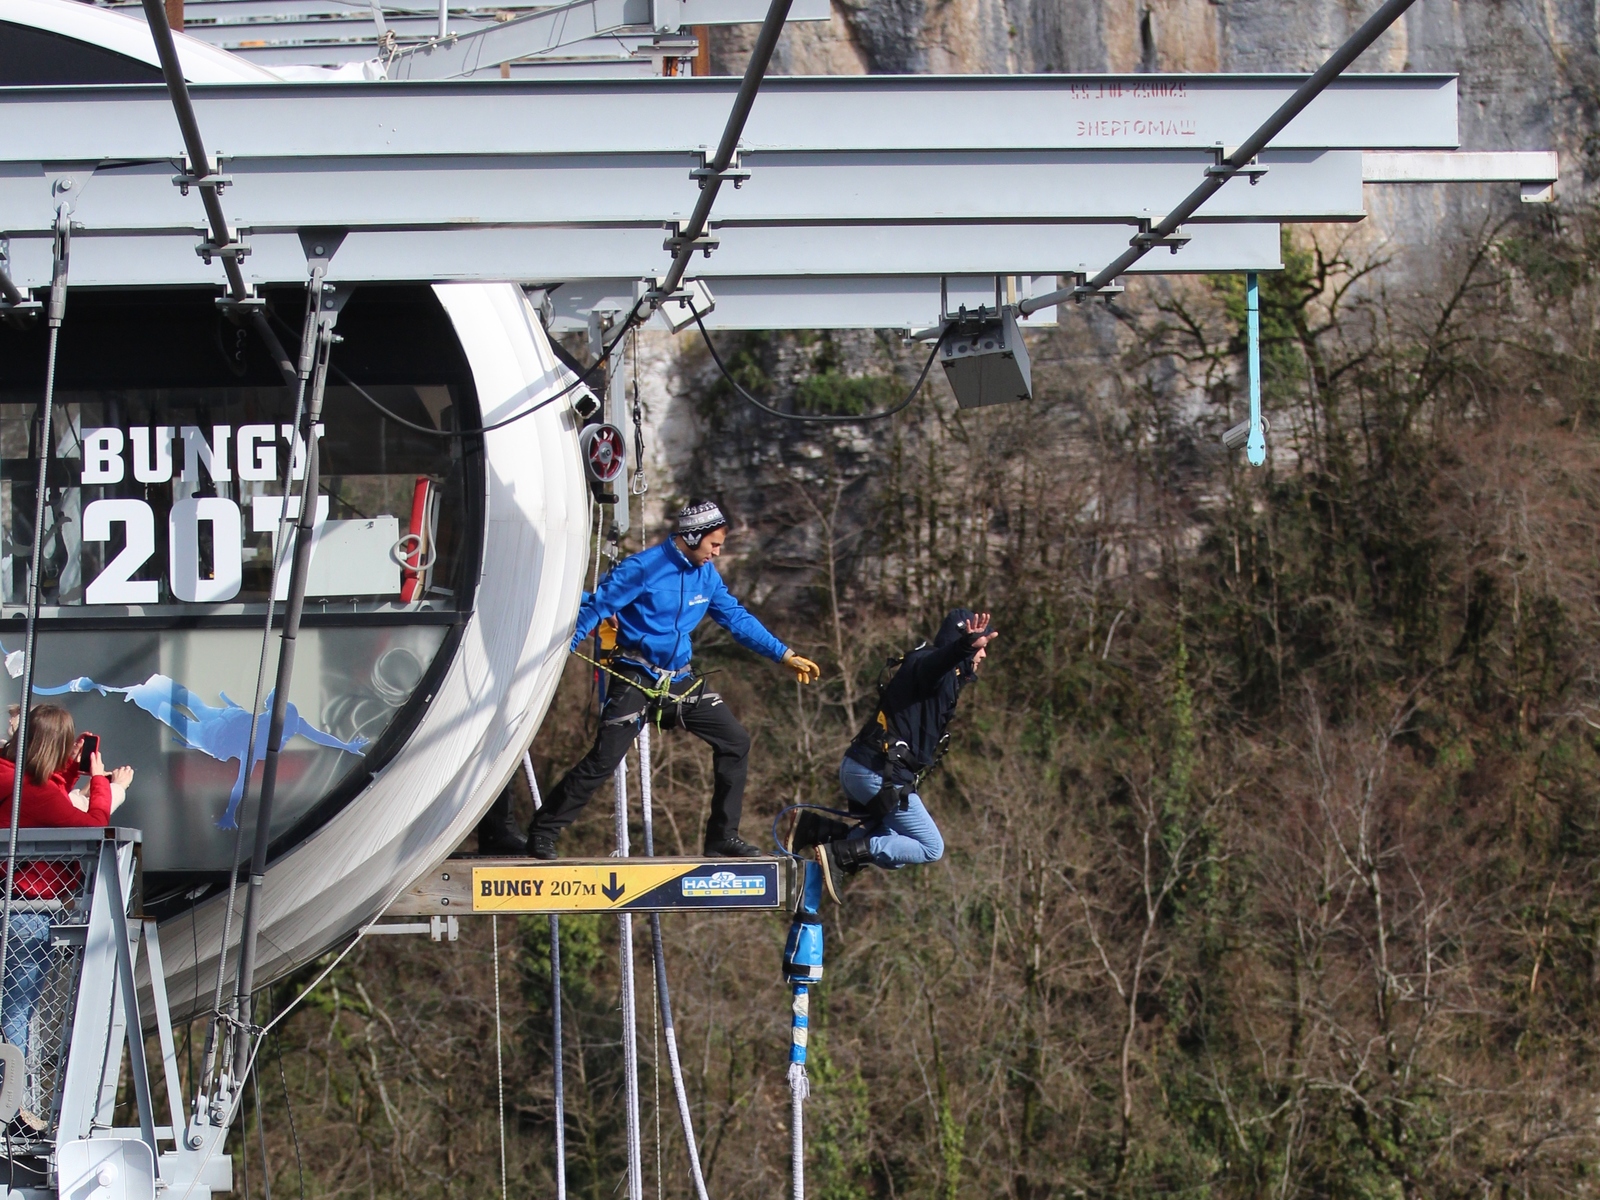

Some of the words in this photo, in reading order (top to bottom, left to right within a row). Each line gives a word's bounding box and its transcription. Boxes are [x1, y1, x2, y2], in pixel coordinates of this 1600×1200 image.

[1076, 120, 1196, 136] ЭНЕРГОМАШ
[81, 423, 325, 484] BUNGY
[82, 495, 330, 604] 207
[480, 880, 544, 897] BUNGY
